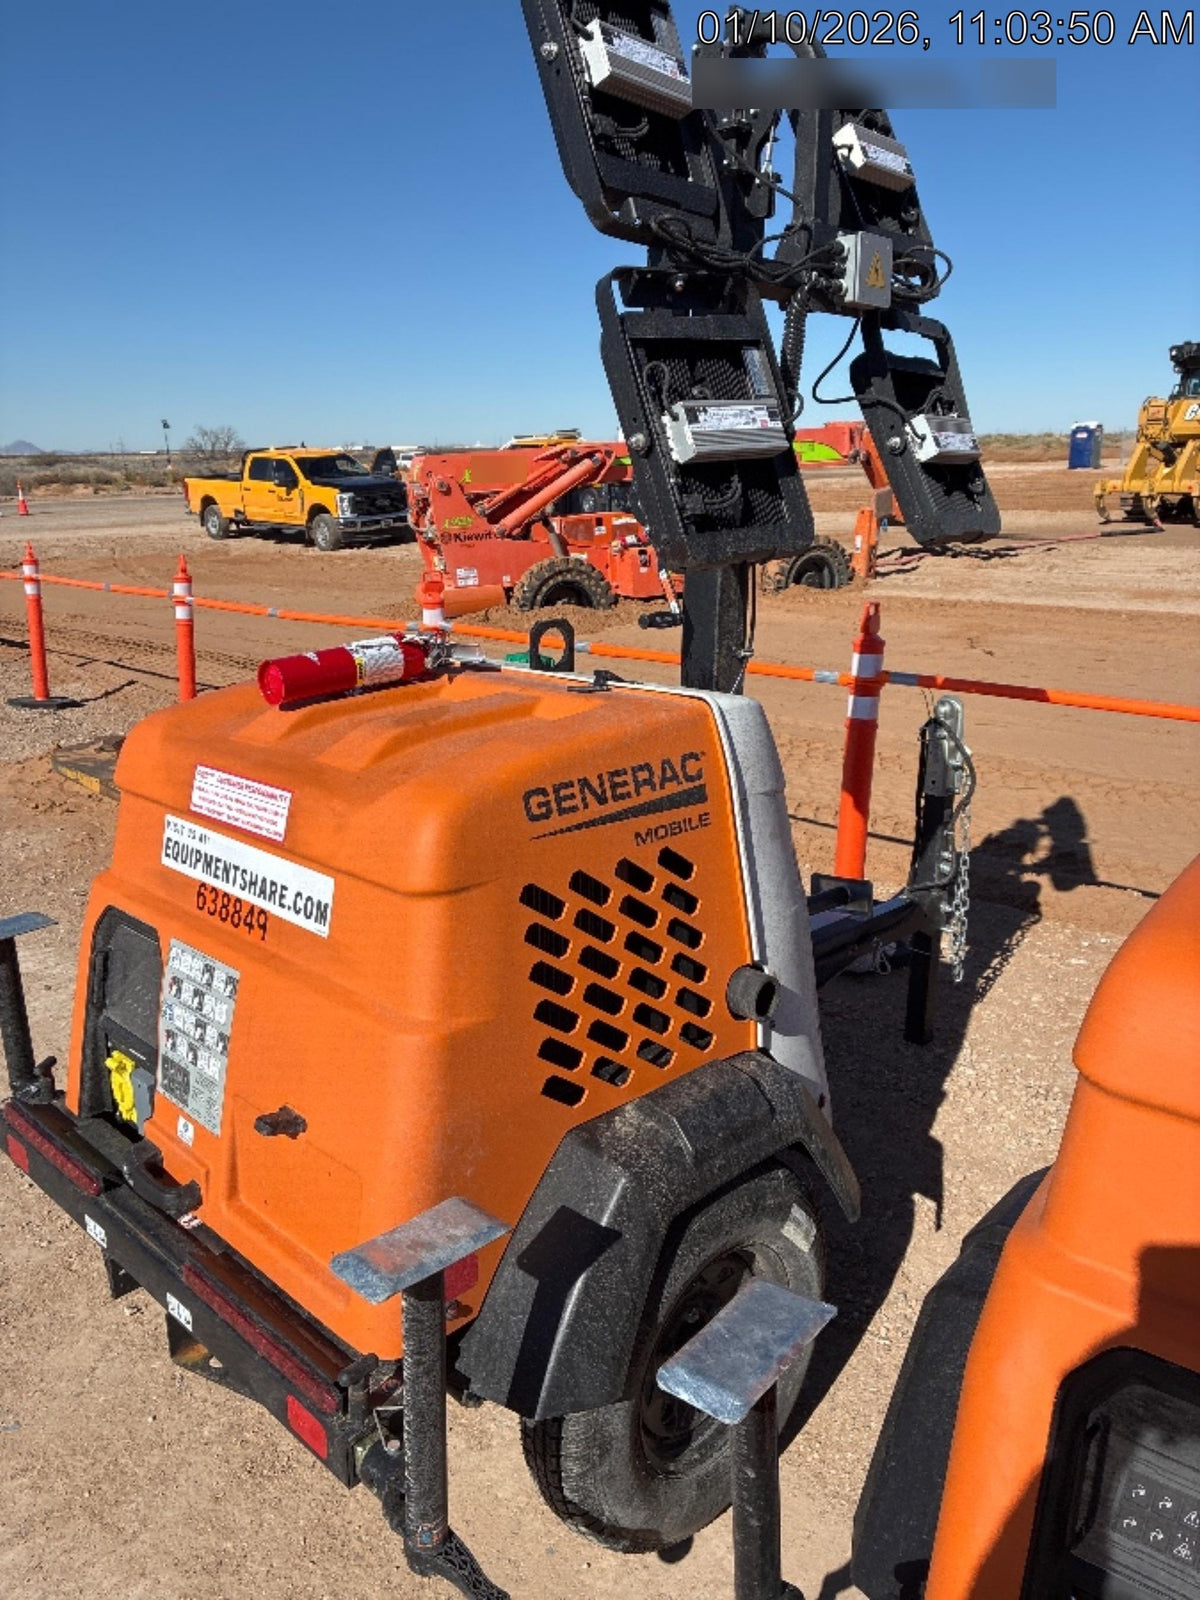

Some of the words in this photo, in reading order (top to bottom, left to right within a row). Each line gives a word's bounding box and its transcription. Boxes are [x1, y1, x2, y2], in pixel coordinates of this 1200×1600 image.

[522, 751, 704, 823] GENERAC
[633, 812, 711, 847] MOBILE
[164, 836, 330, 927] EQUIPMENTSHARE.COM
[196, 881, 269, 941] 638849
